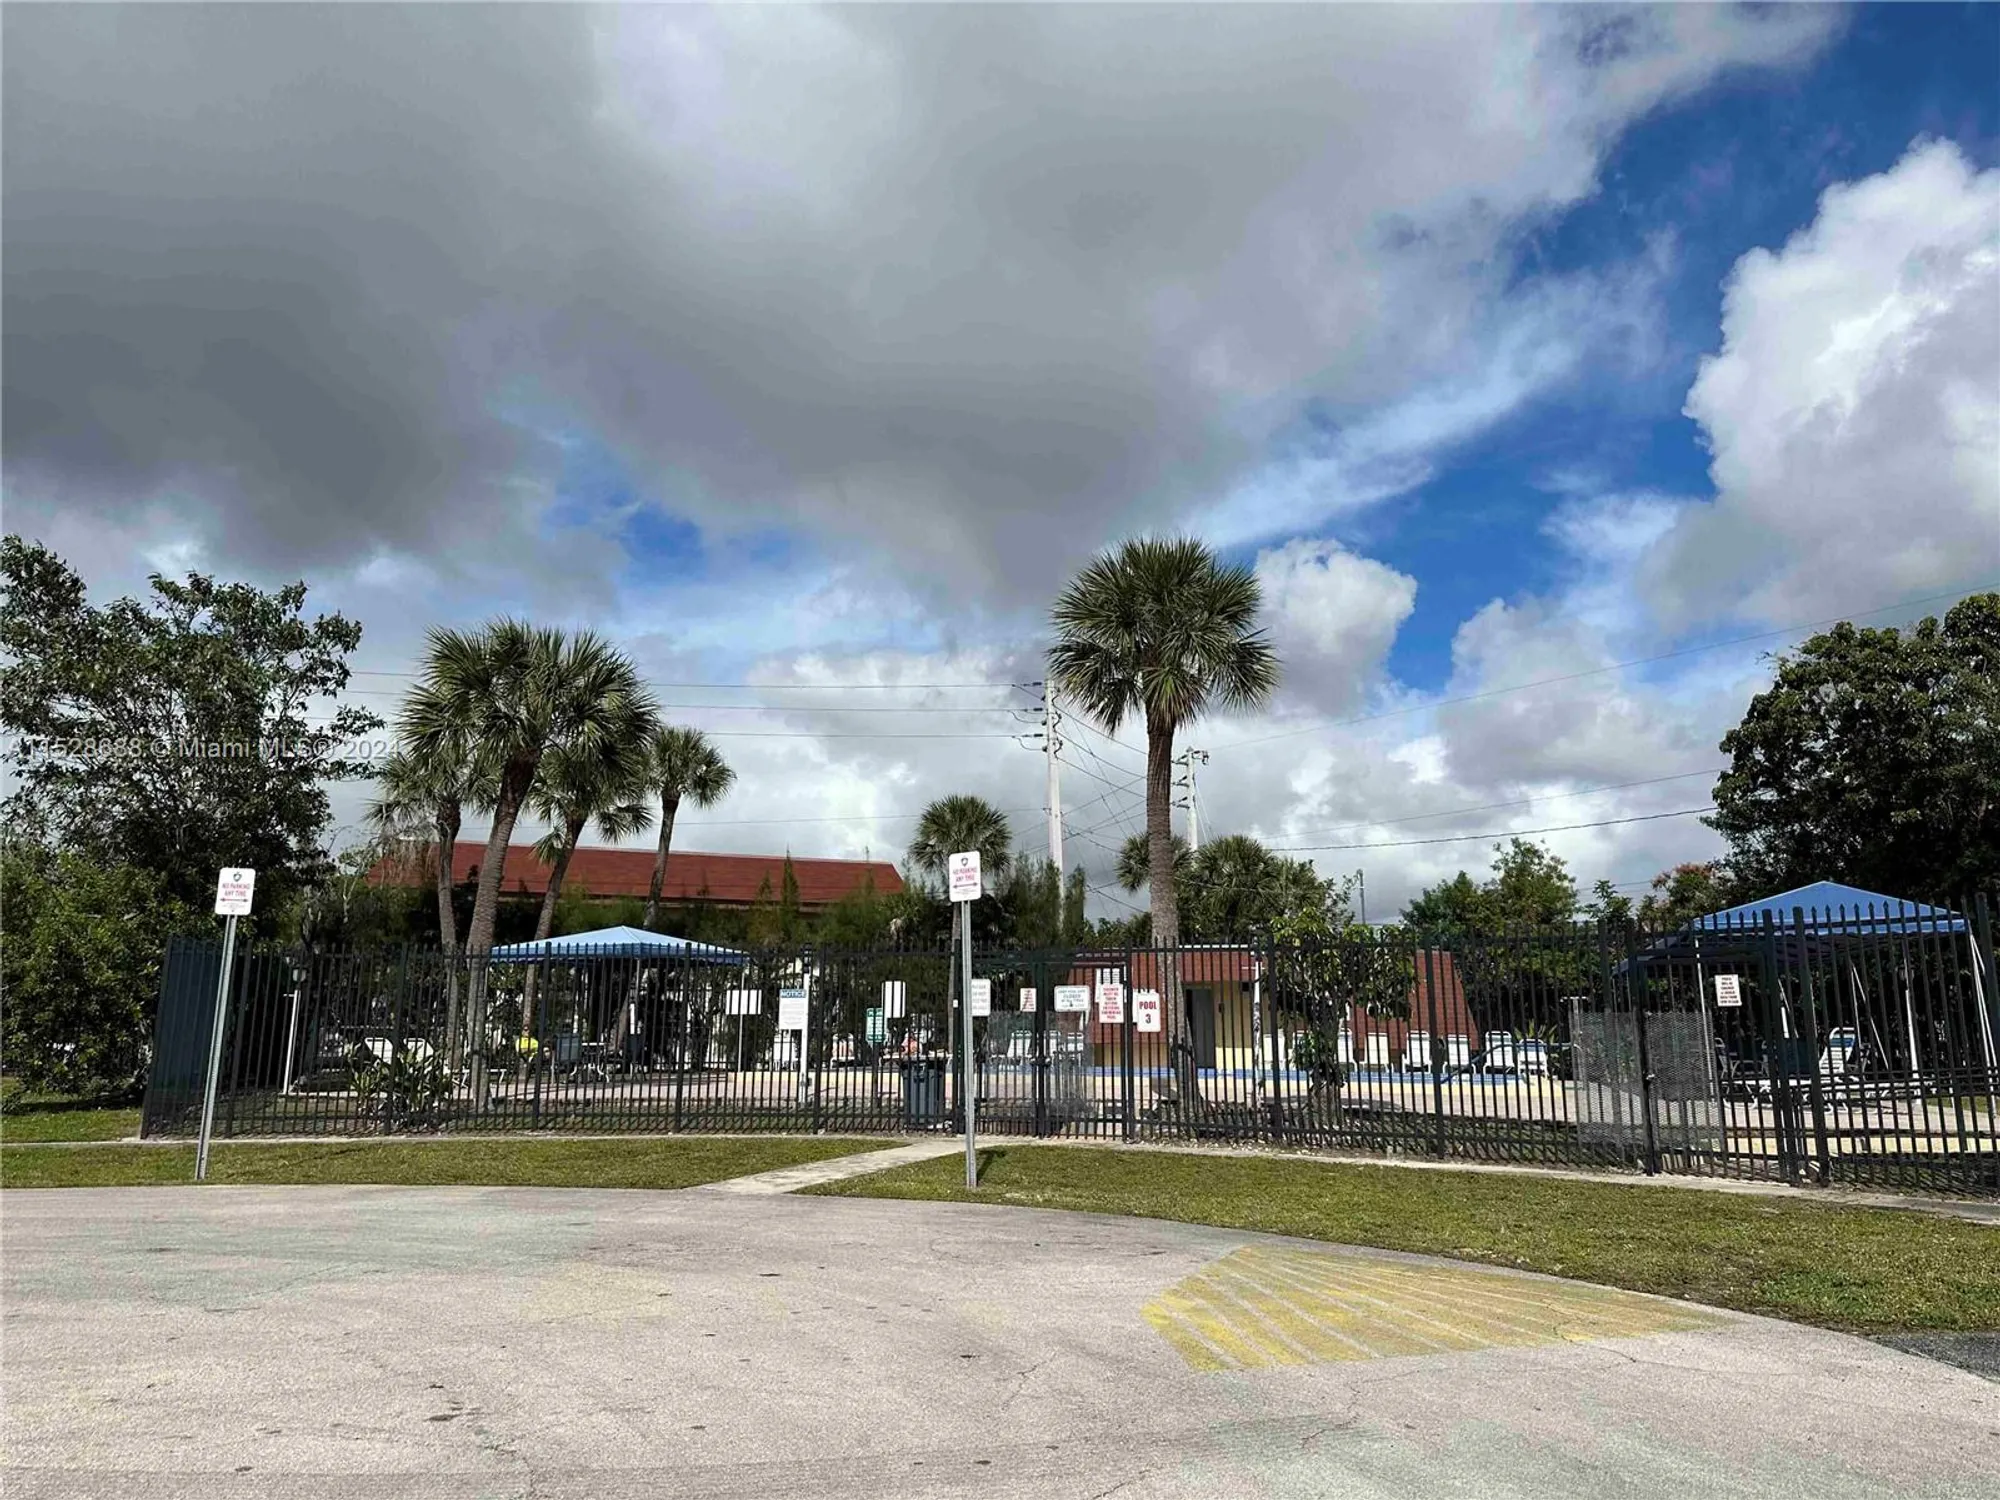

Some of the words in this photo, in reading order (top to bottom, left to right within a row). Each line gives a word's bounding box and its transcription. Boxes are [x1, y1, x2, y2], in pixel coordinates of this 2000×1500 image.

[780, 990, 806, 998] NOTICE
[1139, 1001, 1157, 1010] POOL
[1145, 1013, 1151, 1024] 3
